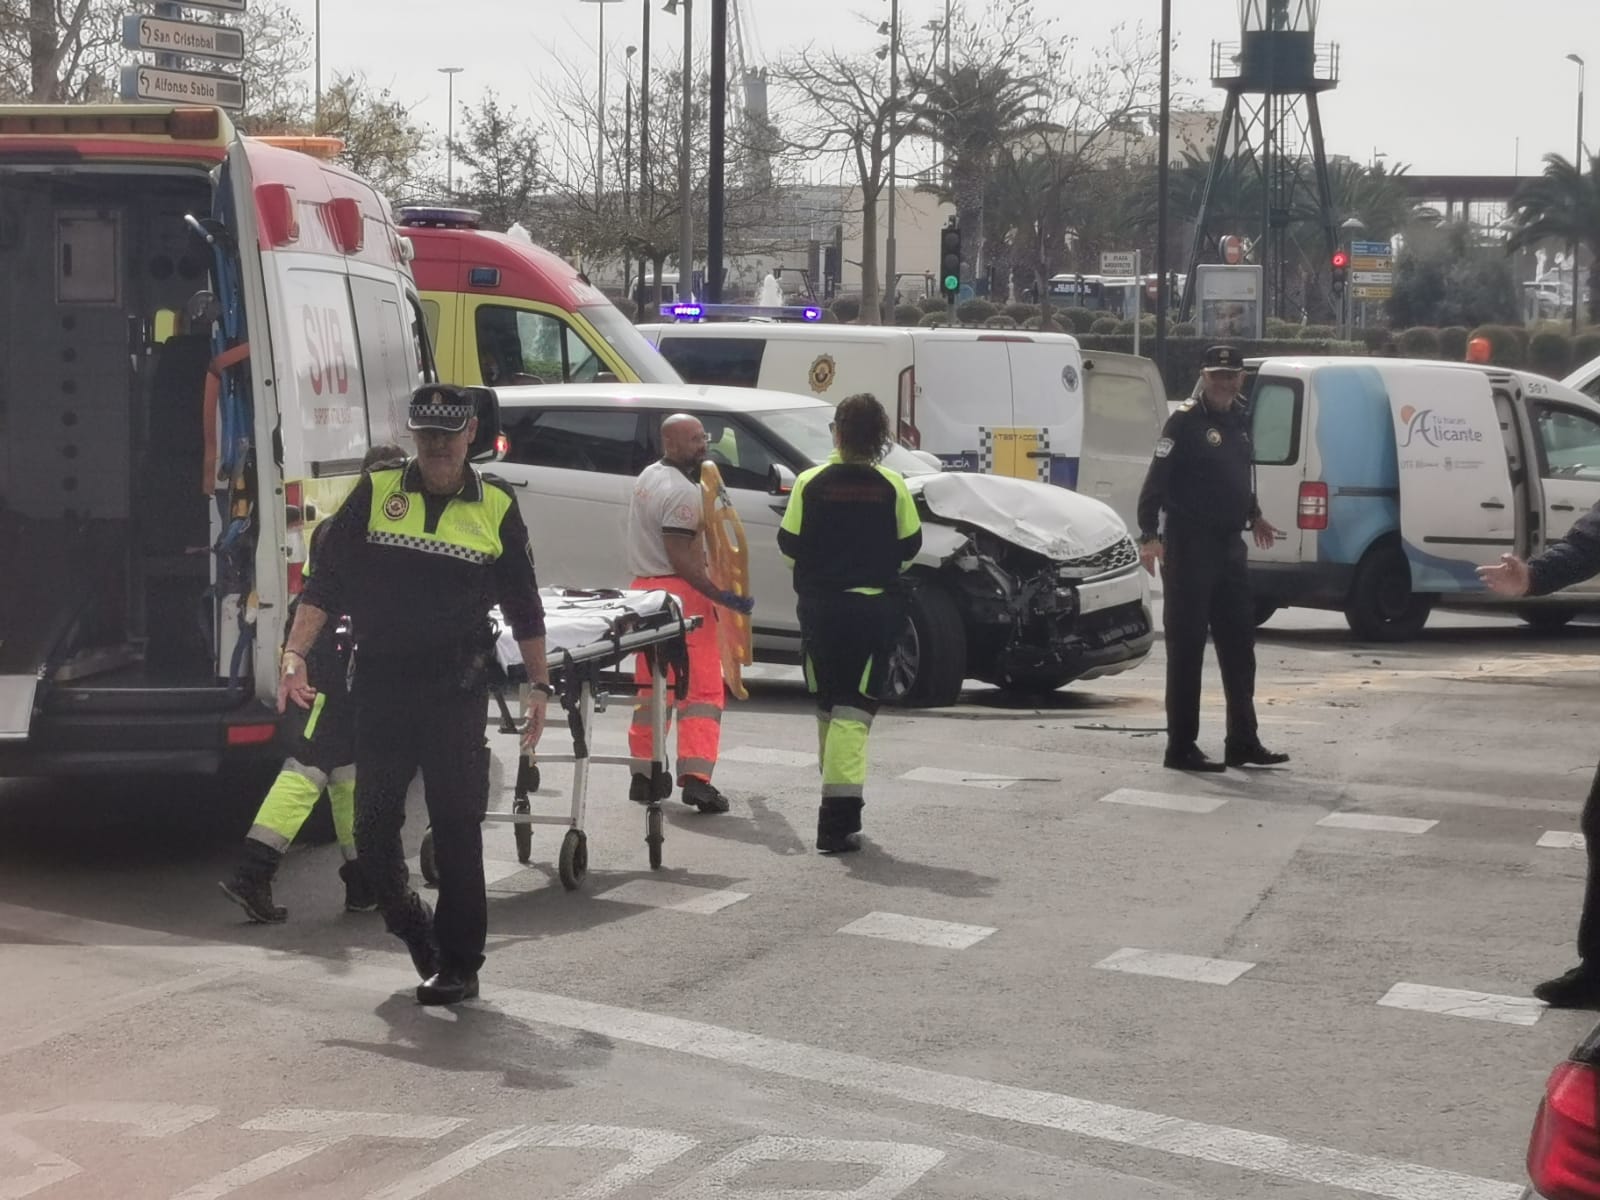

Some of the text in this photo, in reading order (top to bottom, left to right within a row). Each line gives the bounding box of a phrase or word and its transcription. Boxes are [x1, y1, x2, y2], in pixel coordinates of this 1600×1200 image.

[153, 28, 214, 49] San Cristobal
[154, 77, 215, 97] Alfonso Sabio
[302, 304, 349, 396] SVB
[1399, 409, 1483, 449] Alicante
